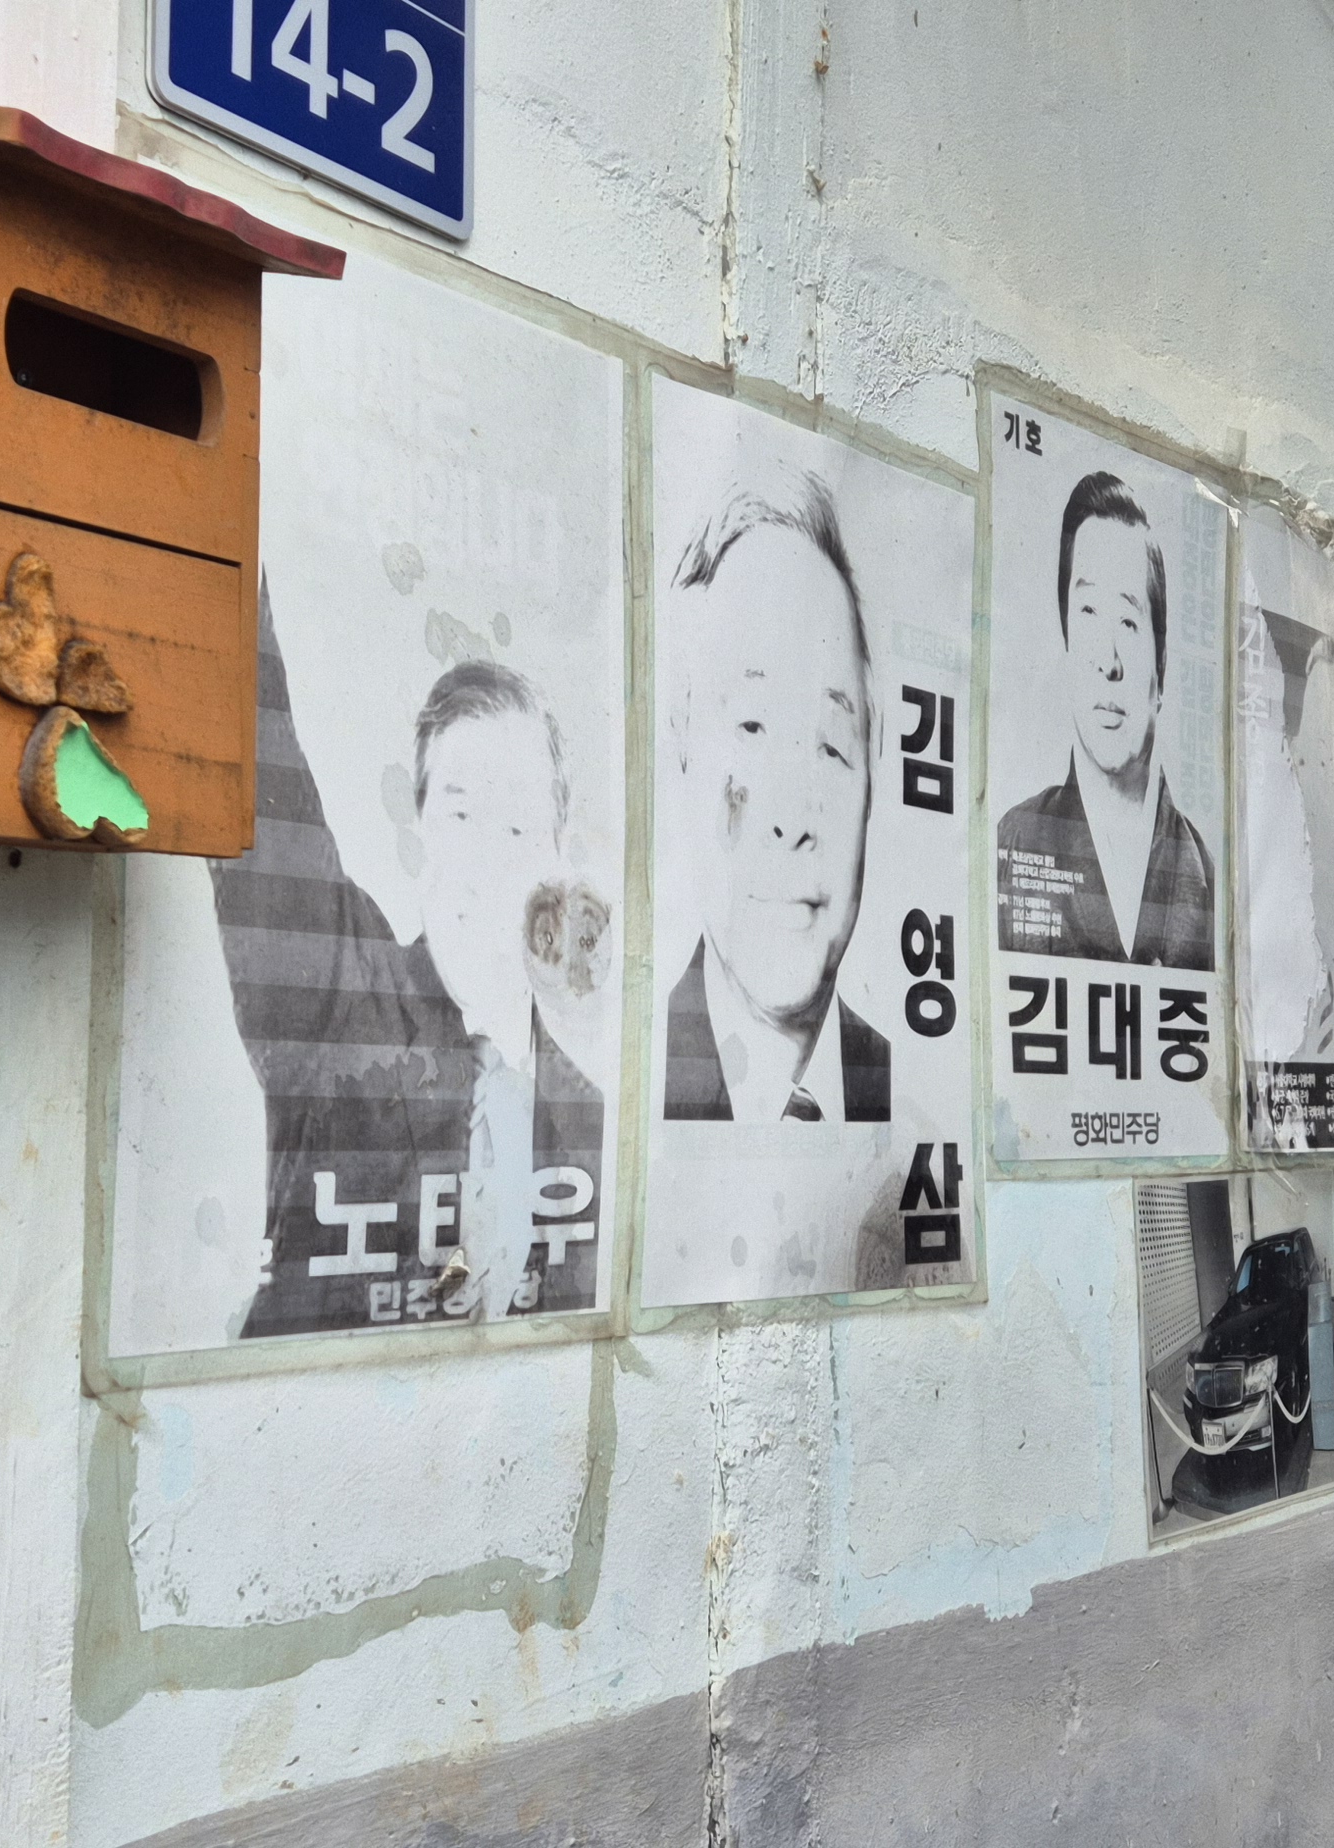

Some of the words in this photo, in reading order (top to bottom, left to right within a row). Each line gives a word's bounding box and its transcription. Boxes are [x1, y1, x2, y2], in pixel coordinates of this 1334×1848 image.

[230, 0, 436, 174] 14-2
[1004, 410, 1043, 457] 기호
[1008, 975, 1210, 1083] 김대중
[1070, 1111, 1161, 1148] 평화민주당
